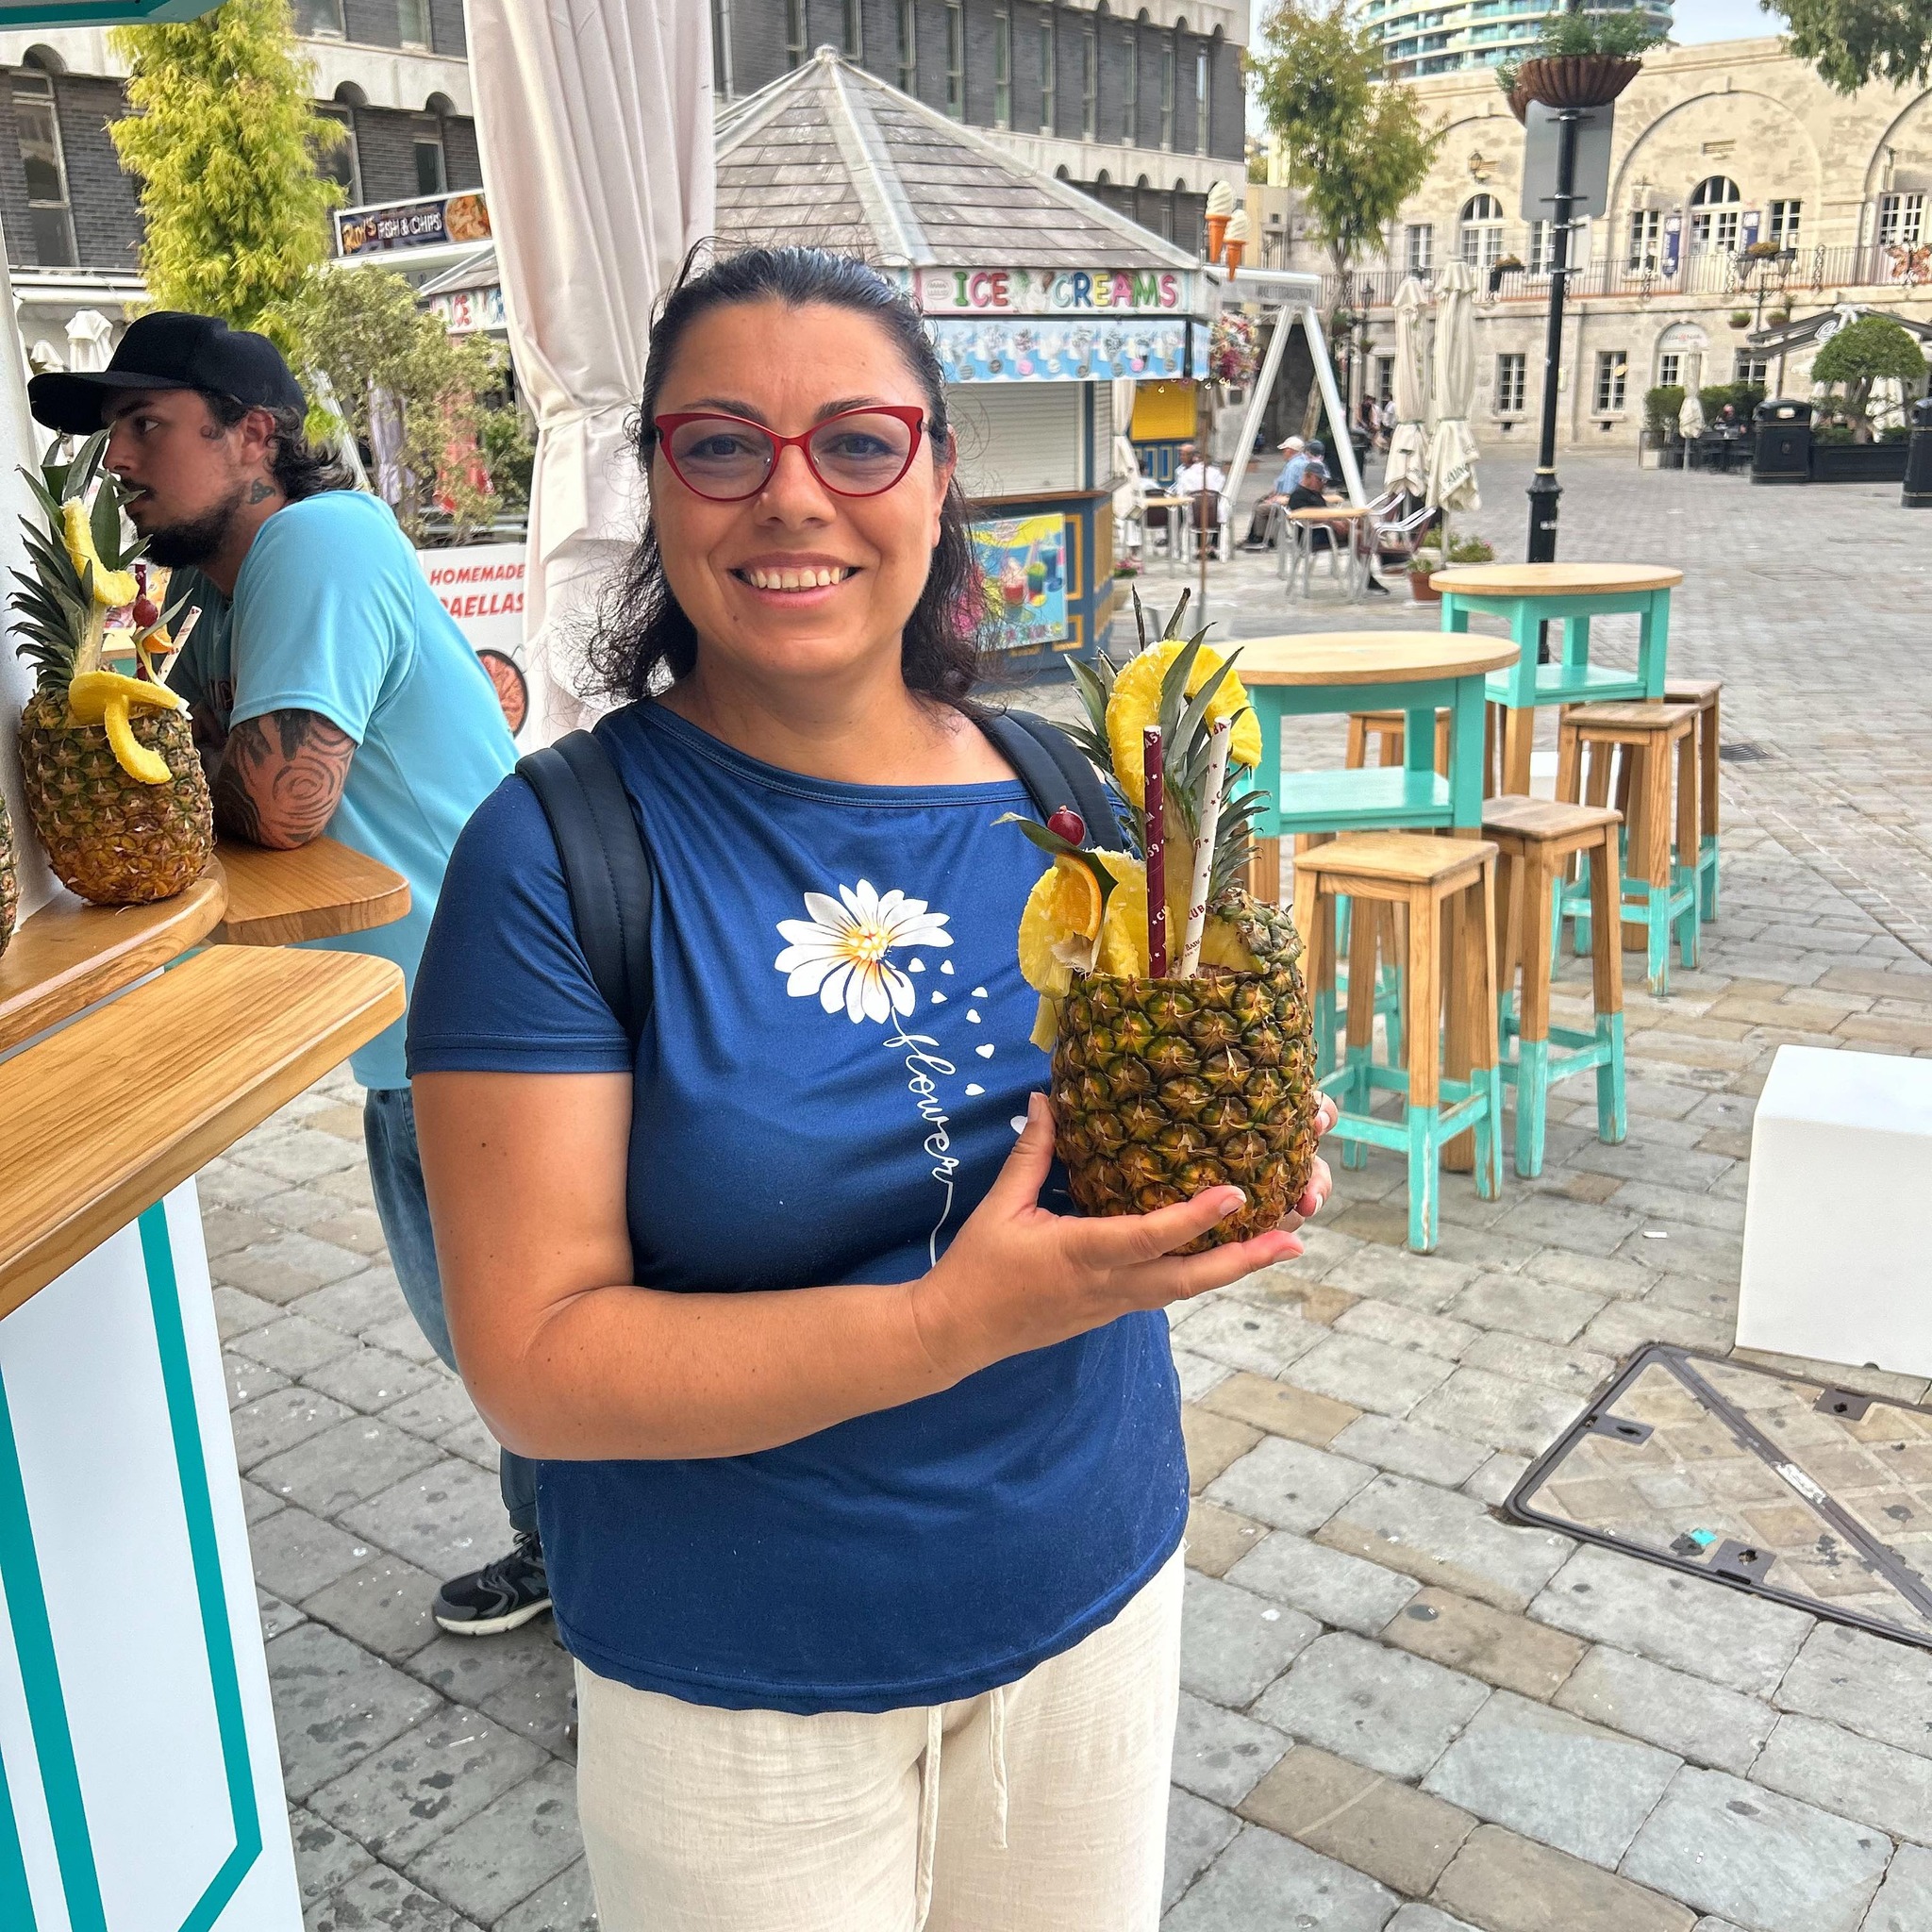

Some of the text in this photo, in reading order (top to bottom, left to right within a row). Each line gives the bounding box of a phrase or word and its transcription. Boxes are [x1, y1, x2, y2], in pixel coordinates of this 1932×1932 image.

[377, 218, 400, 240] FISH
[400, 217, 410, 236] &
[409, 212, 442, 235] CHIPS
[954, 271, 1008, 308] ICE
[1052, 271, 1177, 308] CREAMS
[430, 564, 525, 585] HOMEMADE
